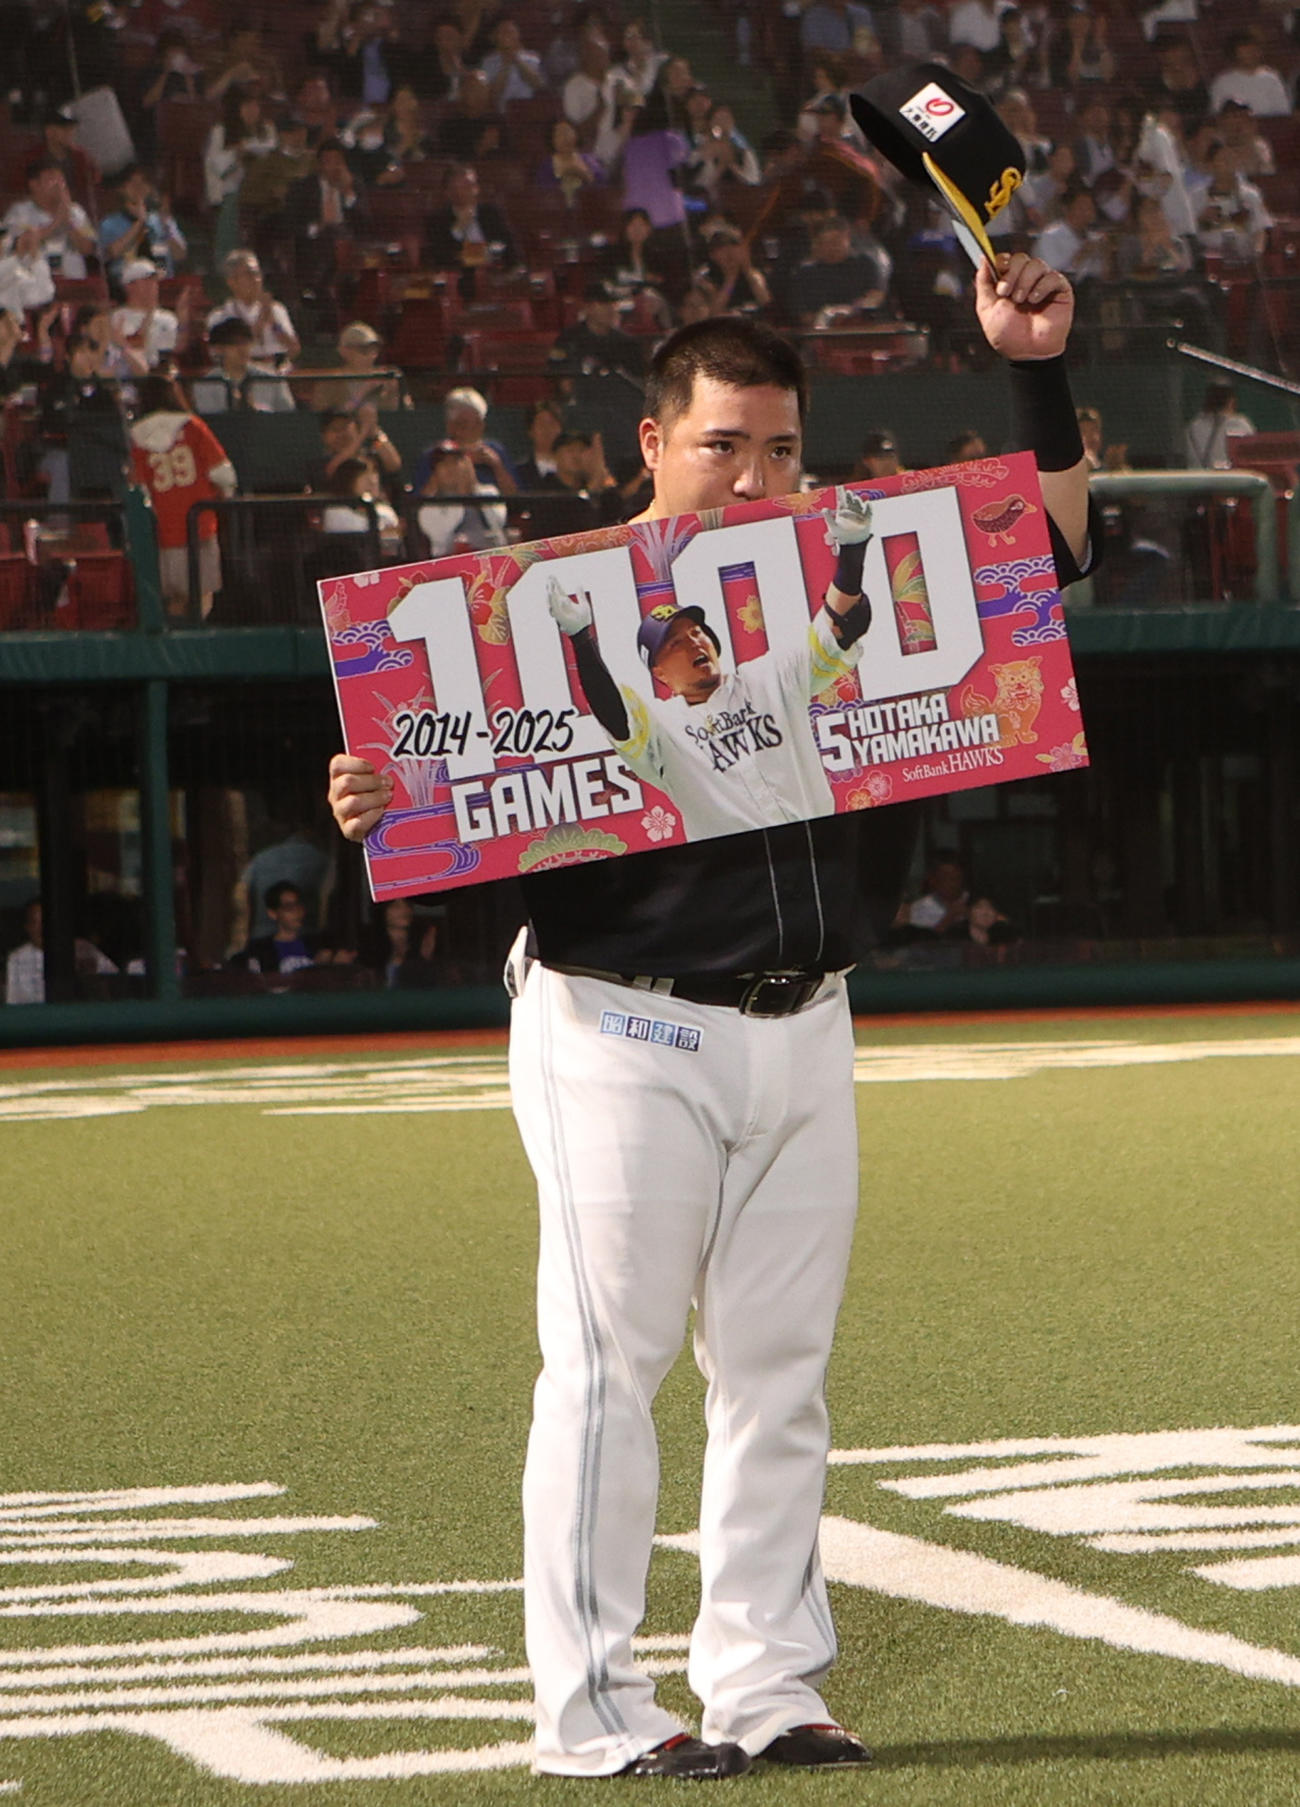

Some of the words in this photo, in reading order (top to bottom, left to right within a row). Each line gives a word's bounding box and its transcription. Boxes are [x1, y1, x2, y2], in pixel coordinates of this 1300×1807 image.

[149, 444, 197, 492] 39
[387, 486, 985, 781] 1000
[392, 708, 577, 757] 2014-2025
[817, 711, 855, 772] 5
[849, 693, 949, 738] HOTAKA
[851, 714, 1000, 767] YAMAKAWA
[705, 713, 783, 772] AWKS
[902, 761, 949, 783] SoftBank
[948, 746, 1004, 774] HAWKS
[451, 754, 644, 843] GAMES
